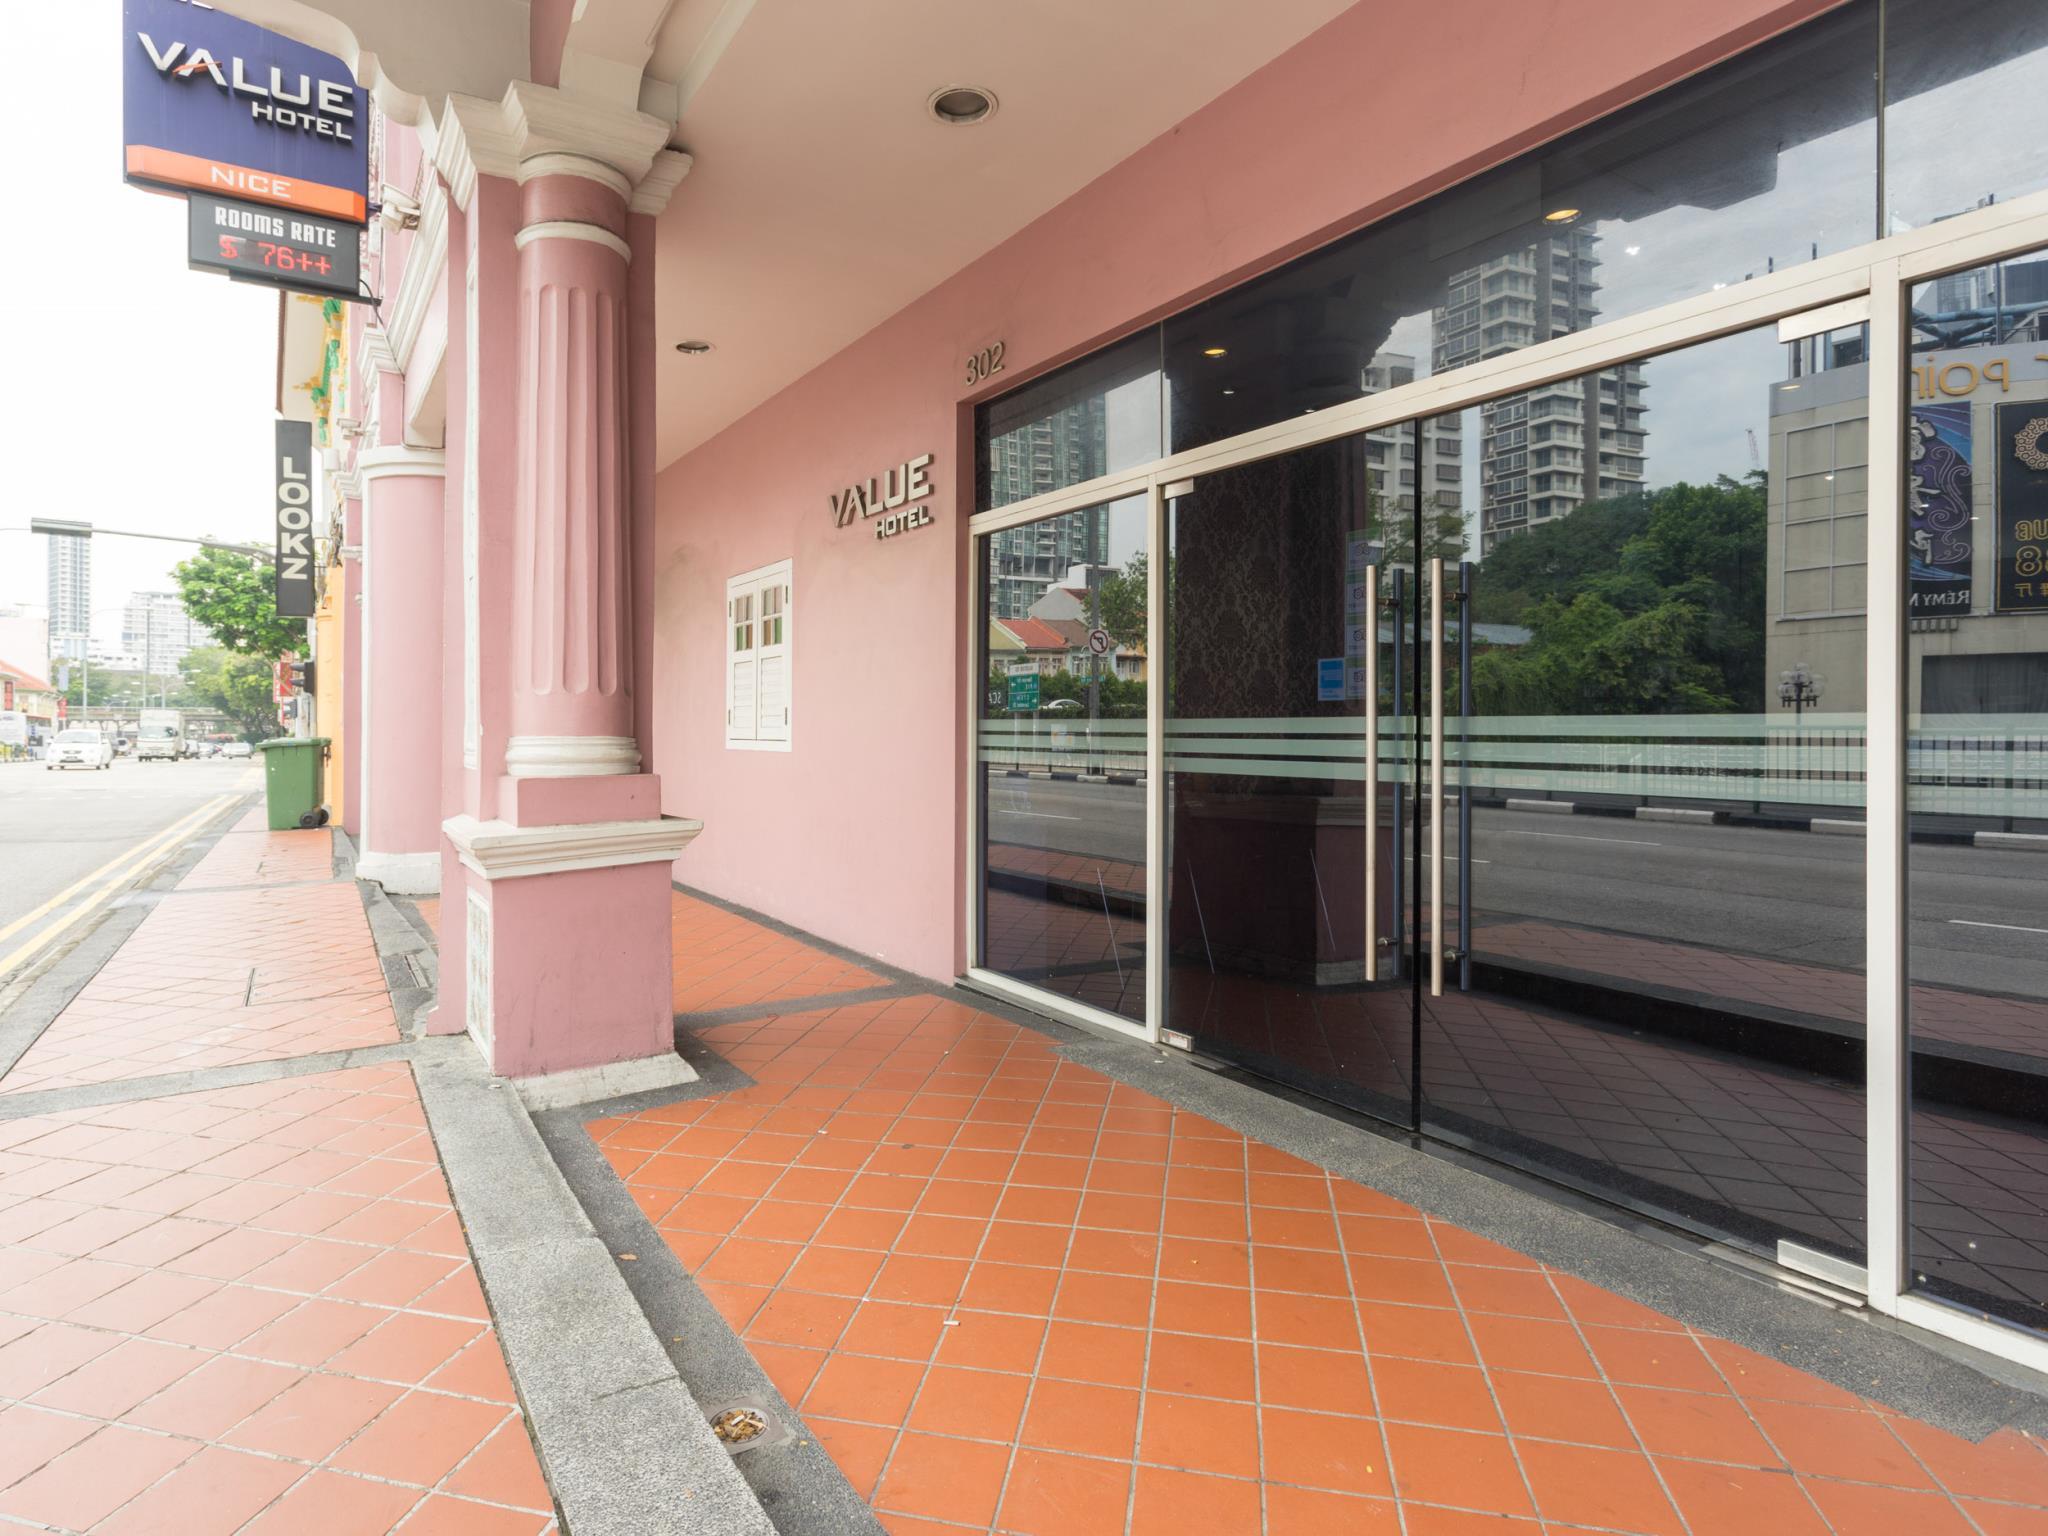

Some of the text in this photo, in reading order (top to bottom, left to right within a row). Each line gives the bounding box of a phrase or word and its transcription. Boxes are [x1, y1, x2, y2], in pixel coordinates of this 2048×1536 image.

[137, 31, 353, 117] VALUE
[252, 101, 352, 140] HOTEL
[210, 166, 291, 199] NICE
[215, 206, 336, 248] ROOMS RATE
[965, 341, 1005, 386] 302
[828, 453, 933, 528] VALUE
[278, 456, 310, 580] LOOKZ
[875, 506, 933, 539] HOTEL
